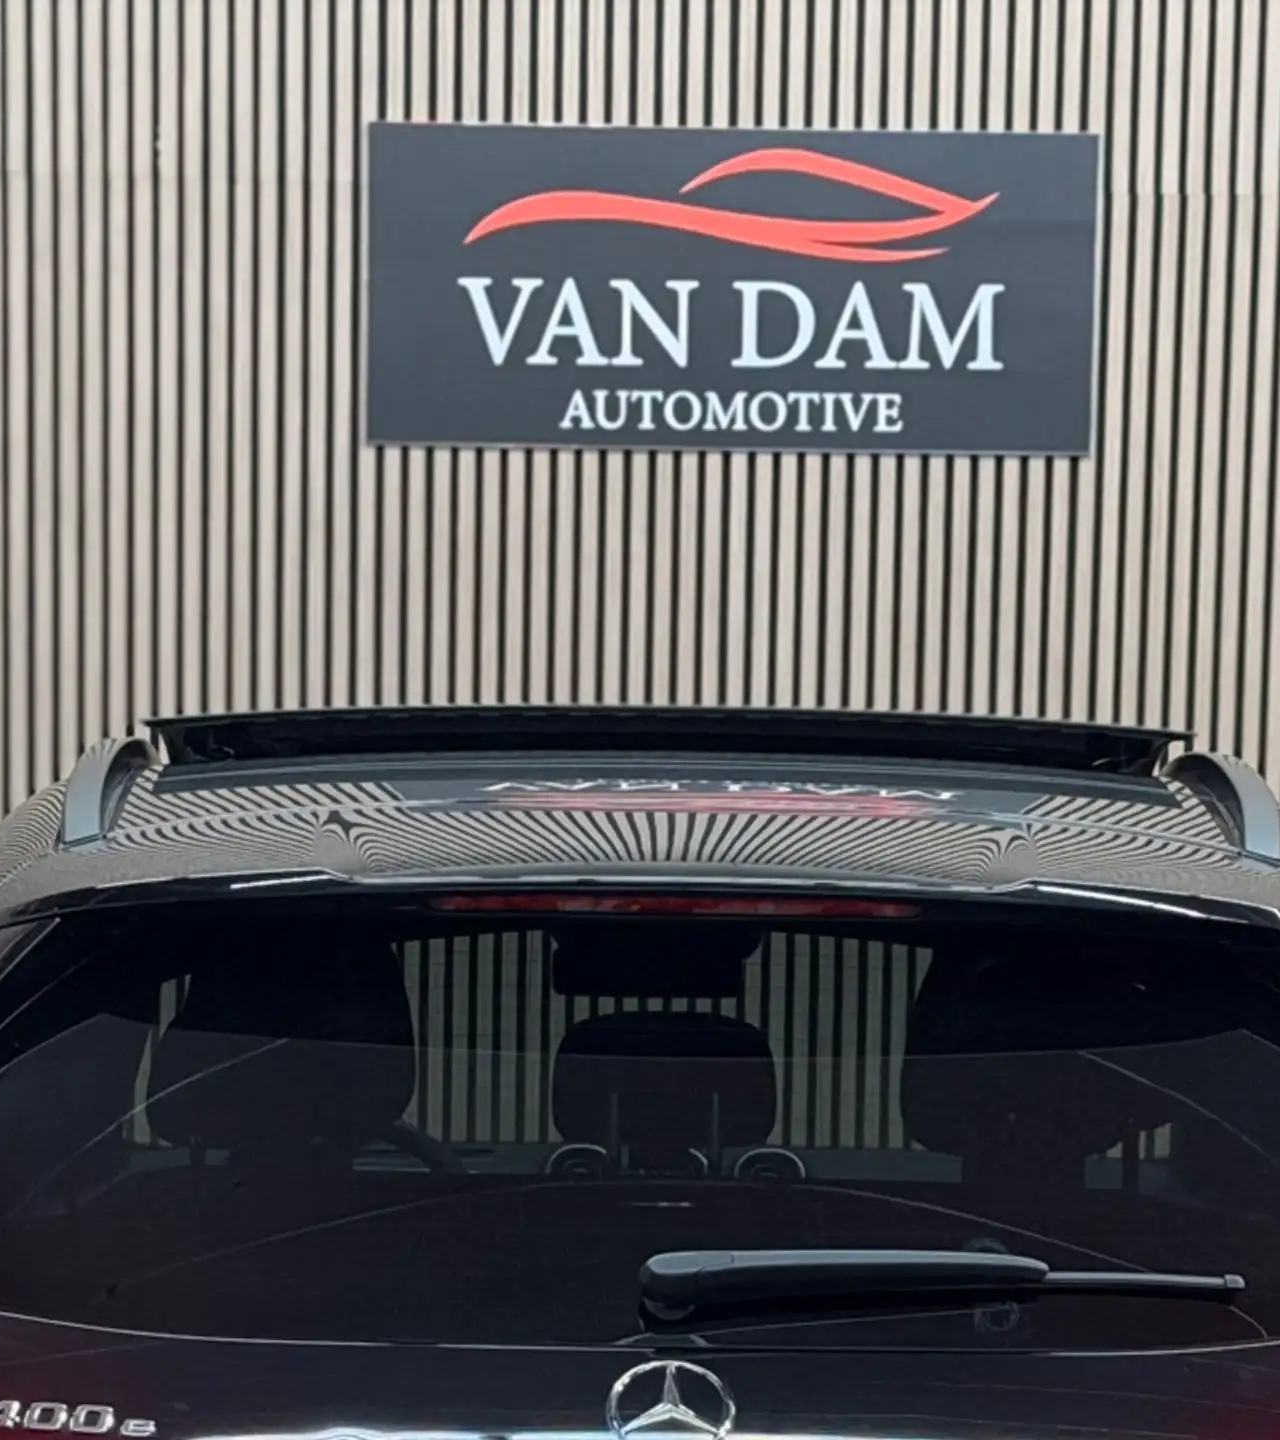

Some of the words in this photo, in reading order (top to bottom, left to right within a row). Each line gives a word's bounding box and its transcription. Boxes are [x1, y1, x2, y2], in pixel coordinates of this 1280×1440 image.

[457, 276, 700, 368] VAN
[731, 280, 1006, 371] DAM
[558, 389, 904, 433] AUTOMOTIVE
